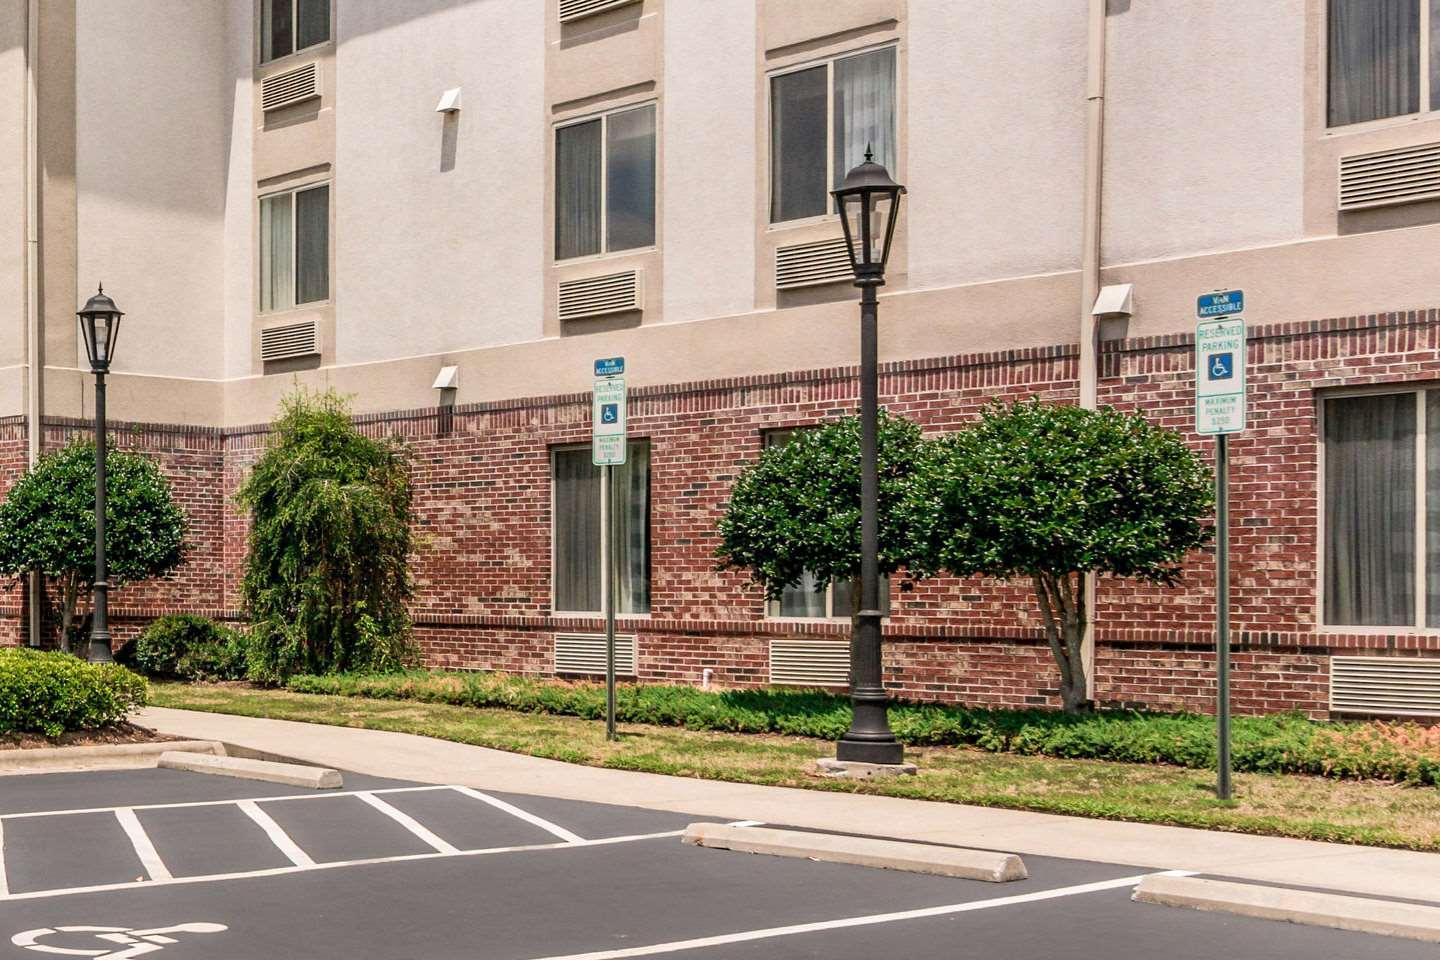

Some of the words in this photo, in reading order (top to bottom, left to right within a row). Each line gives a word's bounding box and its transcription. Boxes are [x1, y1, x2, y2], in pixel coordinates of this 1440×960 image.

[1200, 302, 1241, 314] ACCESSIBLE
[1199, 326, 1241, 339] RESERVED
[1202, 339, 1240, 352] PARKING
